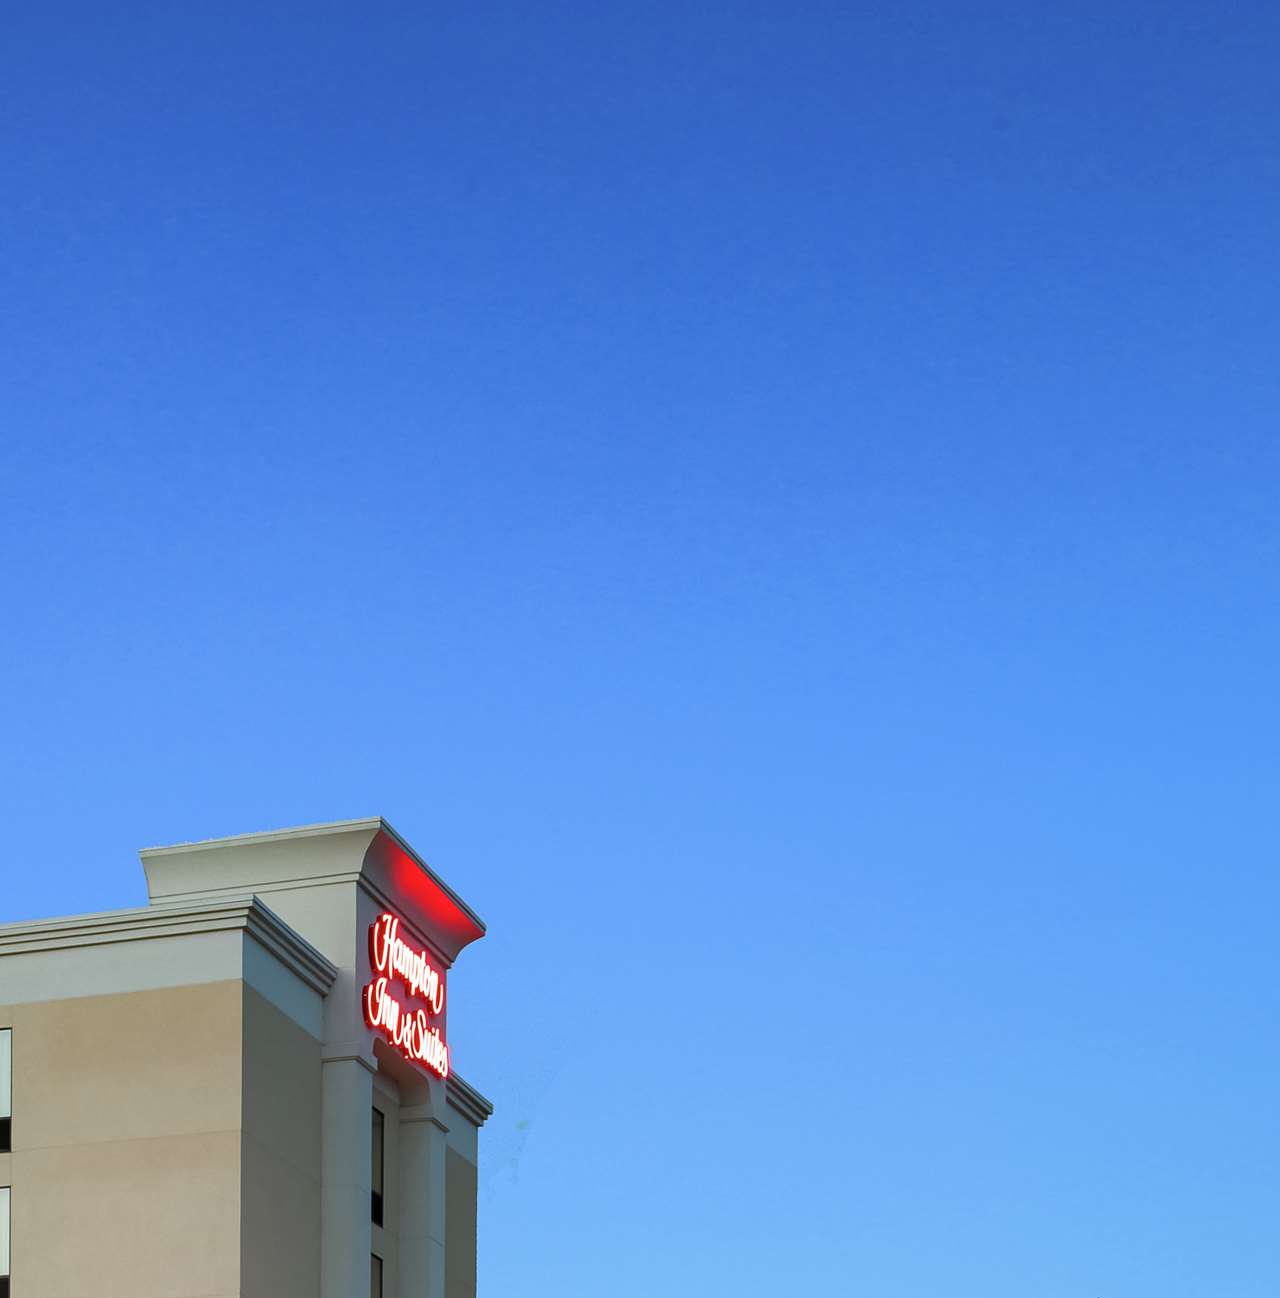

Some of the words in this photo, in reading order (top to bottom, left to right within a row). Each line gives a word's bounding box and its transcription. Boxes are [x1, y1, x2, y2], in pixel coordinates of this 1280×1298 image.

[372, 913, 444, 1015] Hampton
[367, 977, 405, 1046] Inn
[402, 1012, 415, 1059] &
[411, 1009, 450, 1078] Suites
